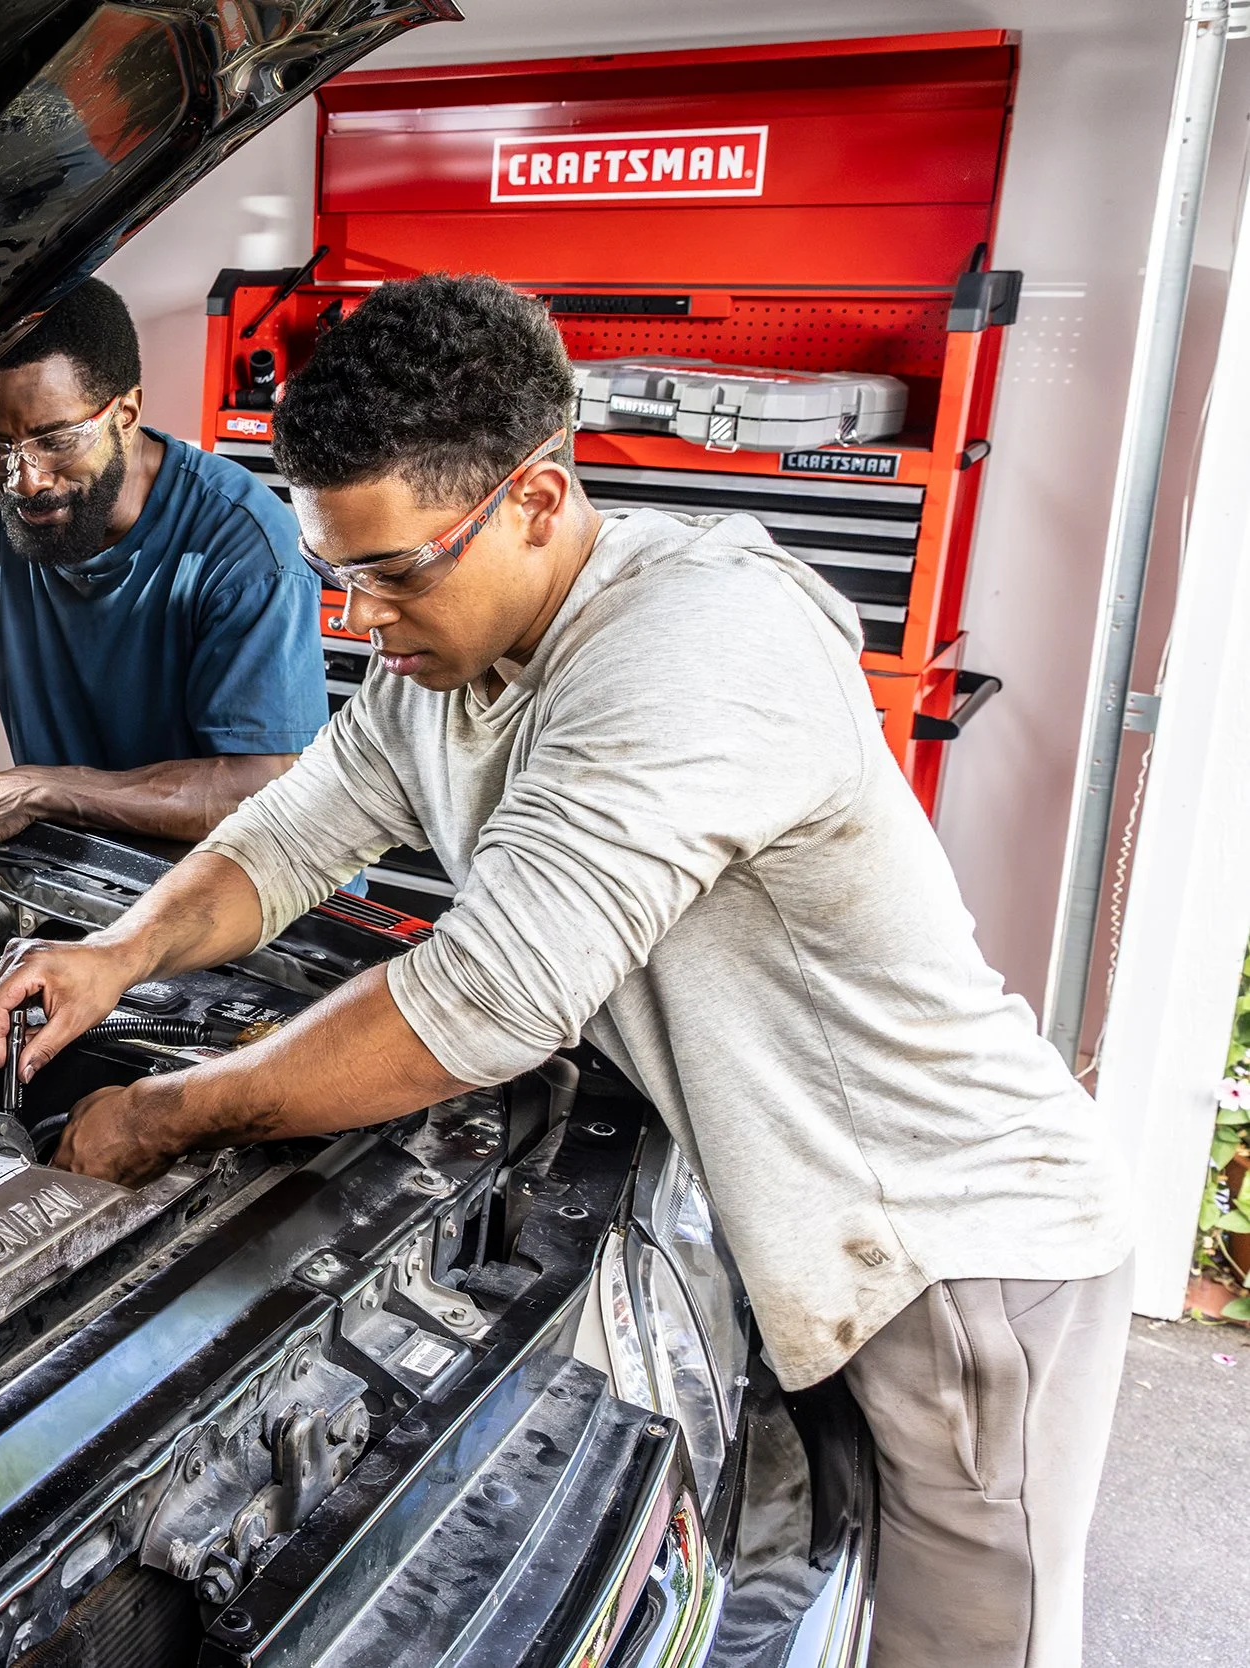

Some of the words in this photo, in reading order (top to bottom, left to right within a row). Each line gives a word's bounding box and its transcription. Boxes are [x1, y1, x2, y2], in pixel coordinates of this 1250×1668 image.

[508, 145, 745, 186] CRAFTSMAN
[612, 400, 674, 417] CRAFTSMAN
[787, 453, 892, 473] CRAFTSMAN
[8, 1182, 83, 1236] FAN
